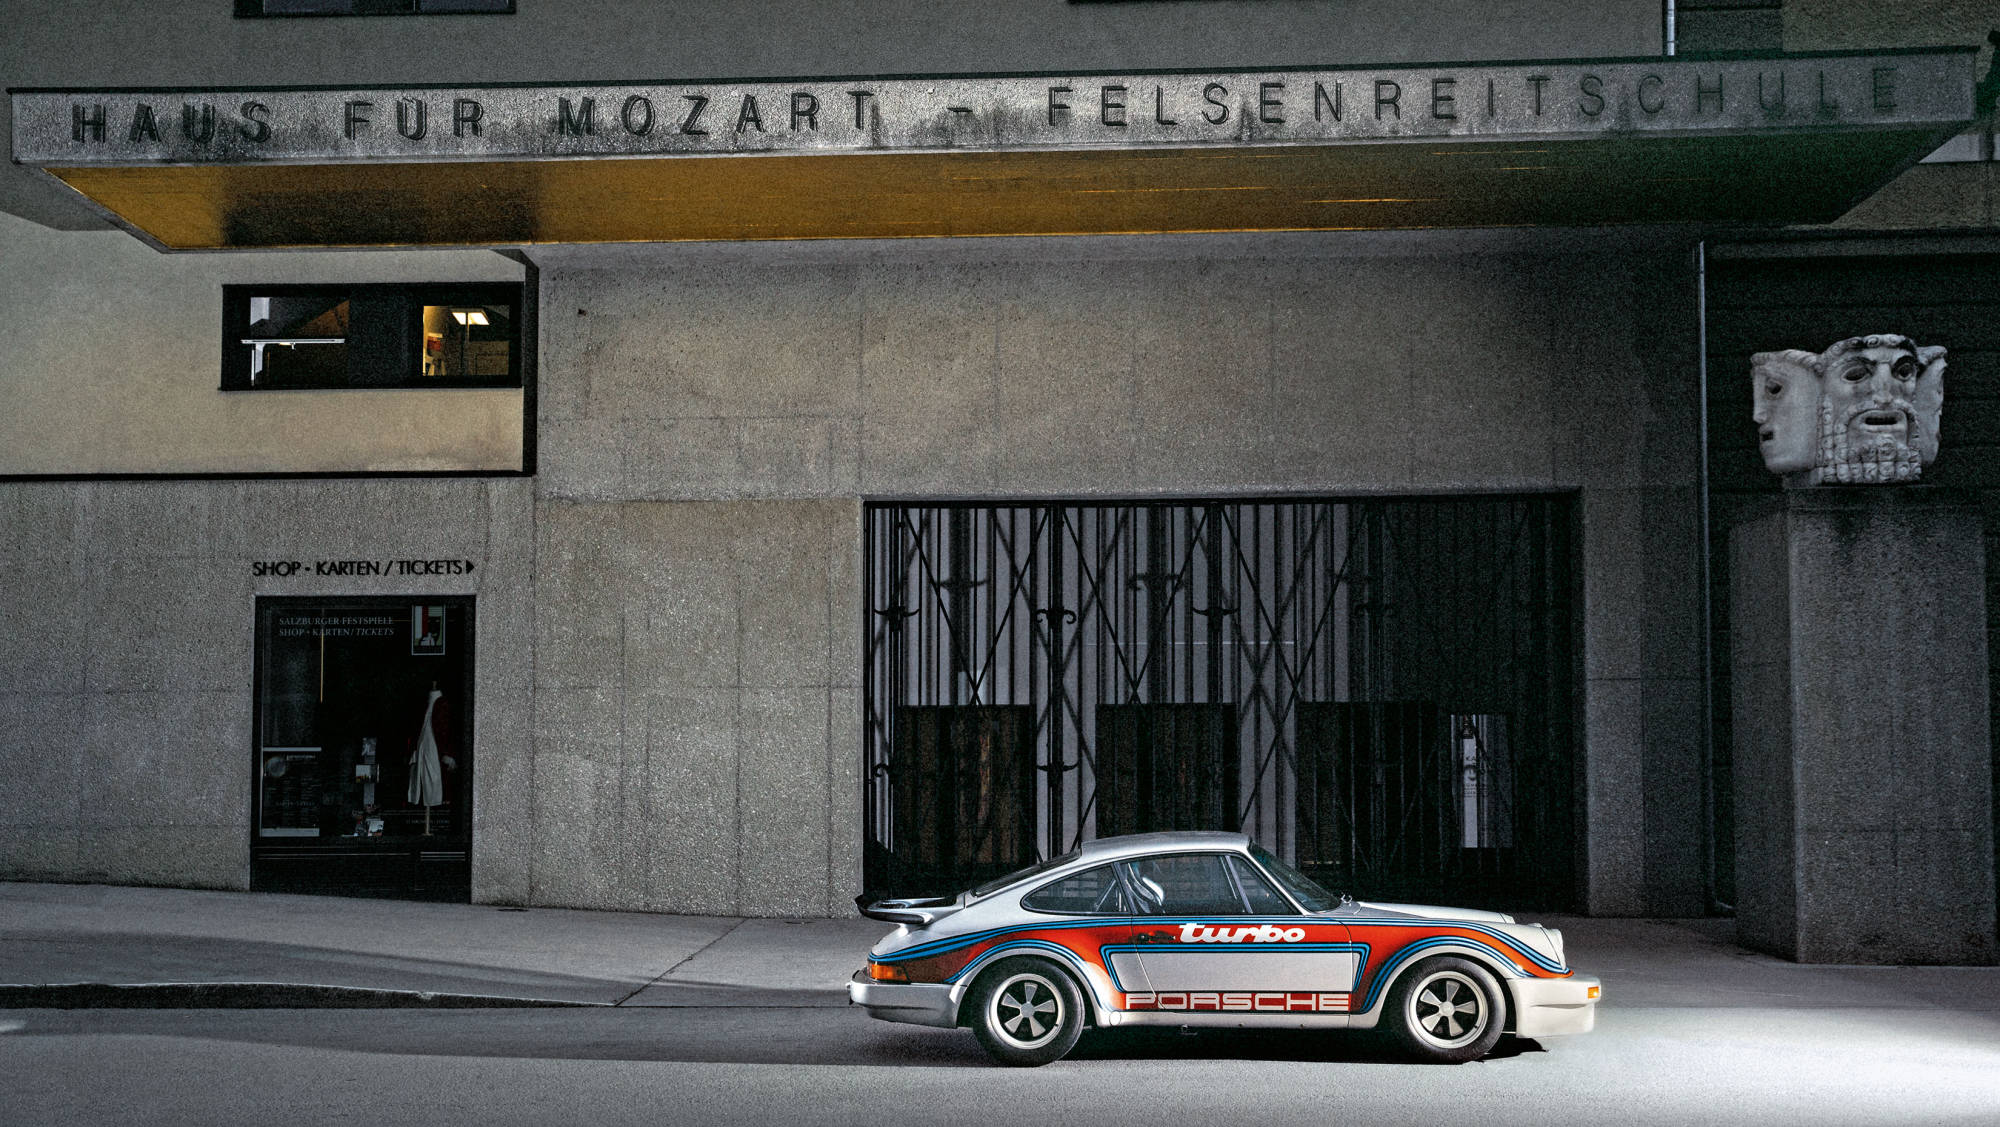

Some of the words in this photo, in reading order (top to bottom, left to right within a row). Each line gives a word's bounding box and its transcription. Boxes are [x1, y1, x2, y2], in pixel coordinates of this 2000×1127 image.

[72, 101, 272, 143] HAUS
[558, 89, 875, 136] MOZART
[1048, 67, 1897, 127] FELSENREITSCHULE
[253, 561, 300, 576] SHOP
[316, 560, 379, 576] KARTEN
[398, 560, 463, 575] TICKETS
[279, 628, 304, 637] SHOP
[356, 627, 395, 636] TICKETS
[1179, 923, 1306, 943] turbo
[1125, 993, 1349, 1011] PORSCHE
